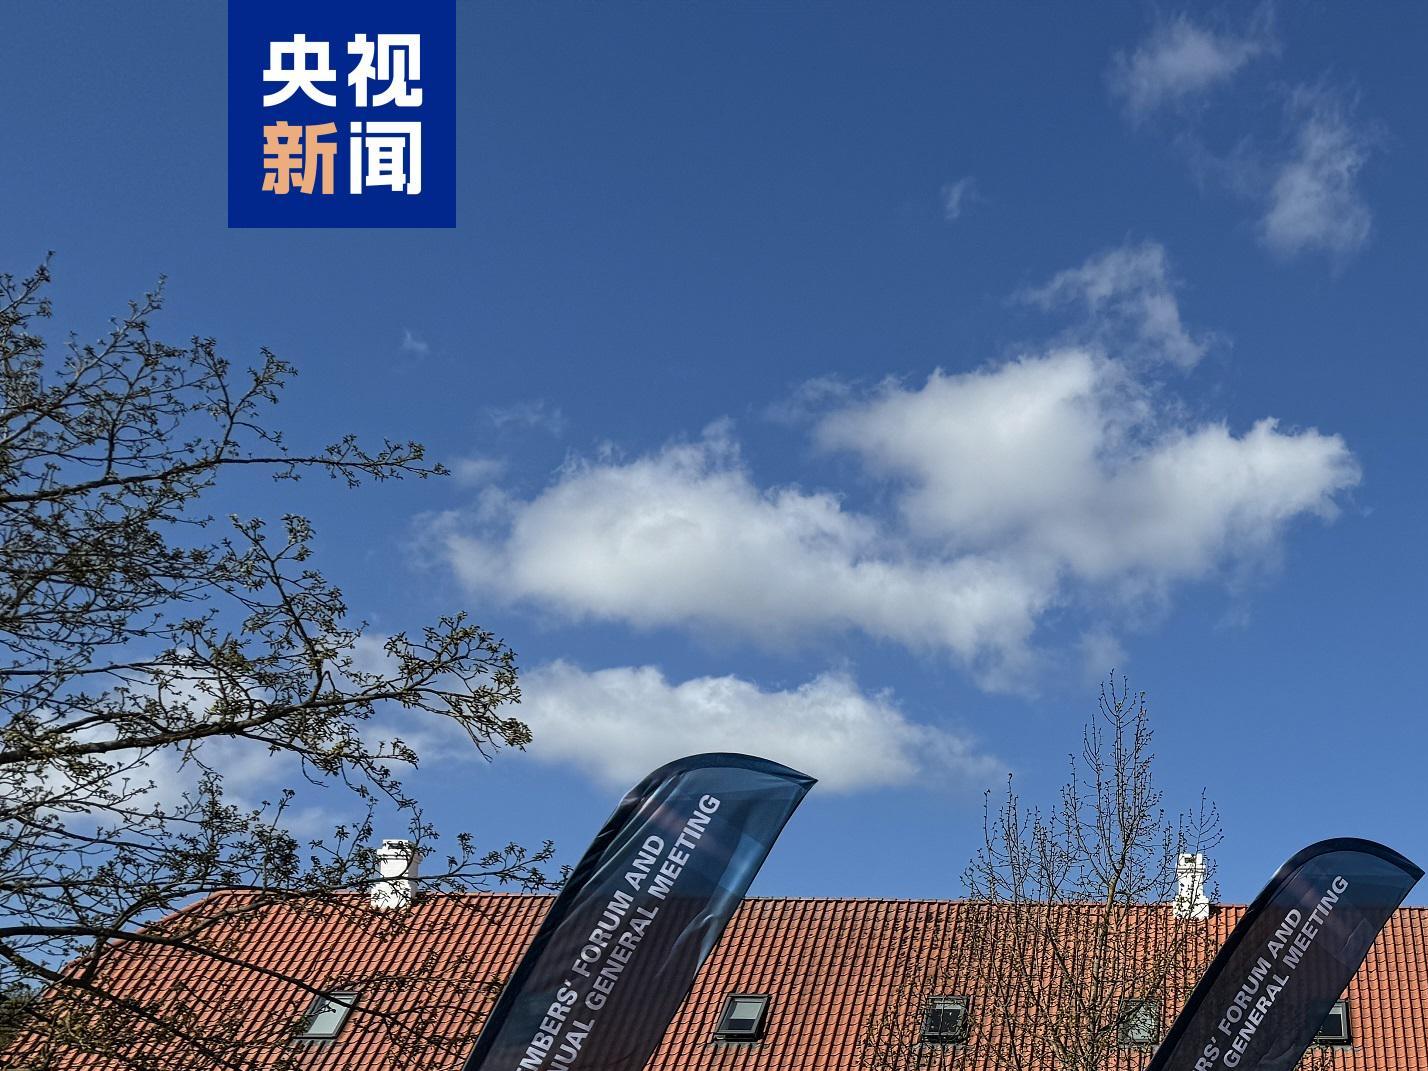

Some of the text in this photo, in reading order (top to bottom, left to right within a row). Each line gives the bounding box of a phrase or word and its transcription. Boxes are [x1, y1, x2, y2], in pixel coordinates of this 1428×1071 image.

[571, 890, 634, 978] FORUM
[624, 835, 665, 891] AND
[584, 906, 659, 1011] GENERAL
[648, 794, 721, 900] MEETING
[1217, 956, 1272, 1036] FORUM
[1267, 908, 1302, 960] AND
[1223, 974, 1290, 1068] GENERAL
[1282, 875, 1349, 970] MEETING
